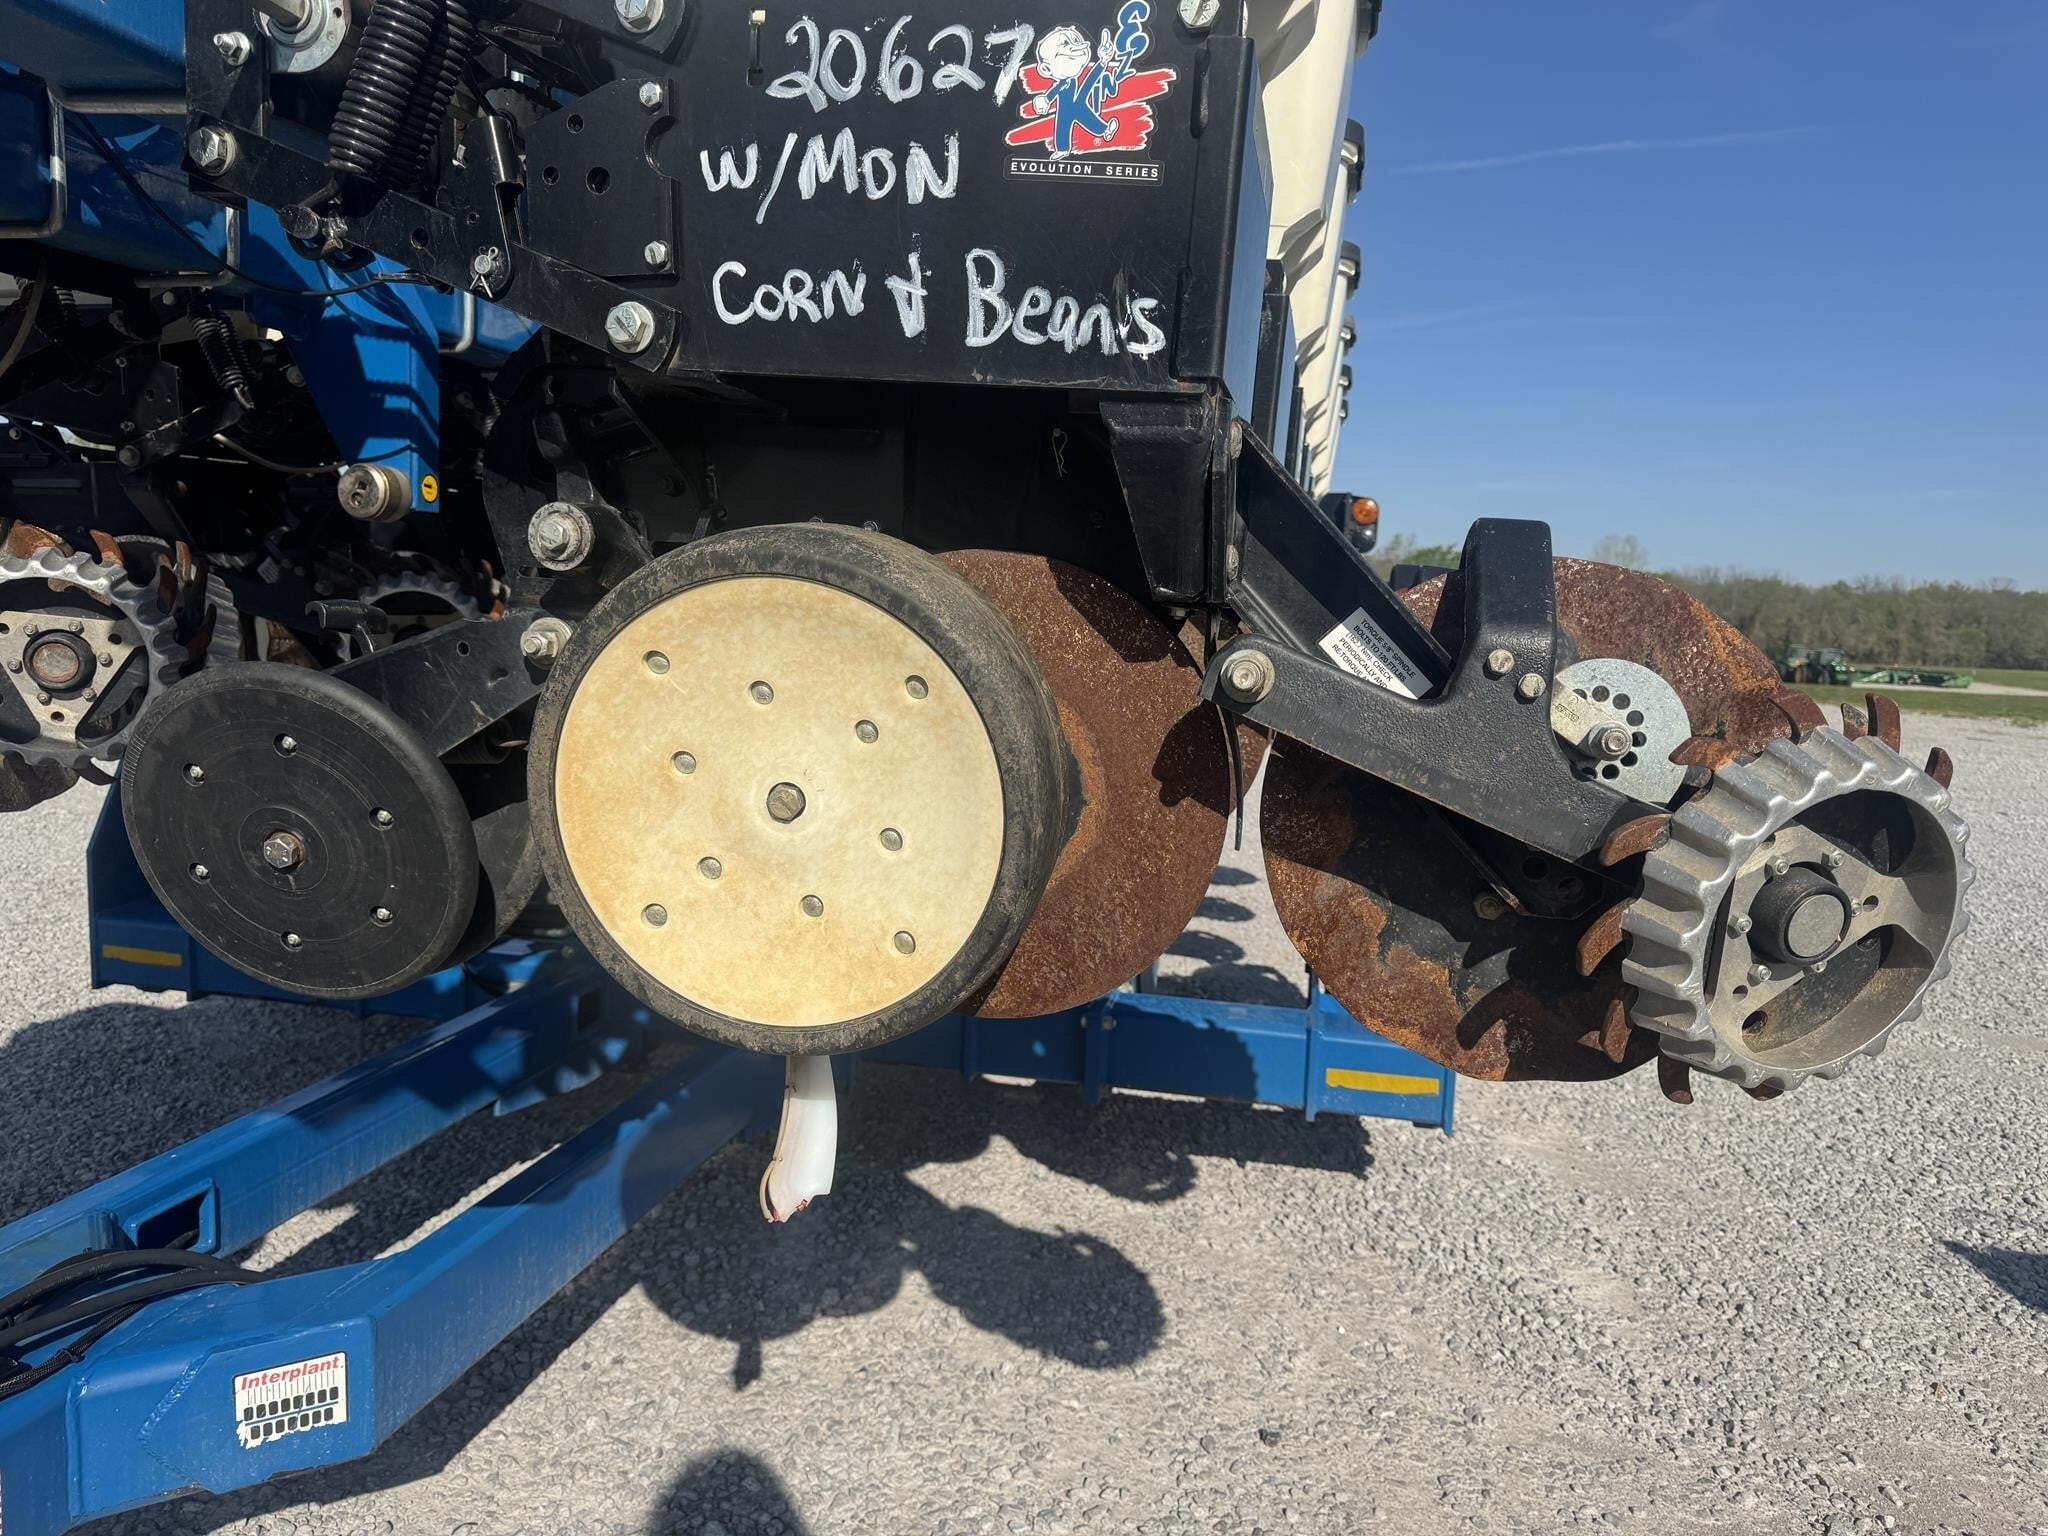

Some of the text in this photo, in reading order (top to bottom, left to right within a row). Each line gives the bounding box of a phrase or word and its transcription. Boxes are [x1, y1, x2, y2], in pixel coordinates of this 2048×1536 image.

[766, 16, 1034, 112] 20627
[1011, 161, 1159, 179] EVOLUTION SERIES
[1353, 625, 1372, 645] BOLTS
[1370, 643, 1380, 653] TO
[1360, 619, 1386, 644] TORQUE
[1391, 653, 1416, 678] SPINDLE
[1339, 638, 1376, 677] PERIODICALLY
[1373, 661, 1393, 681] CHECK
